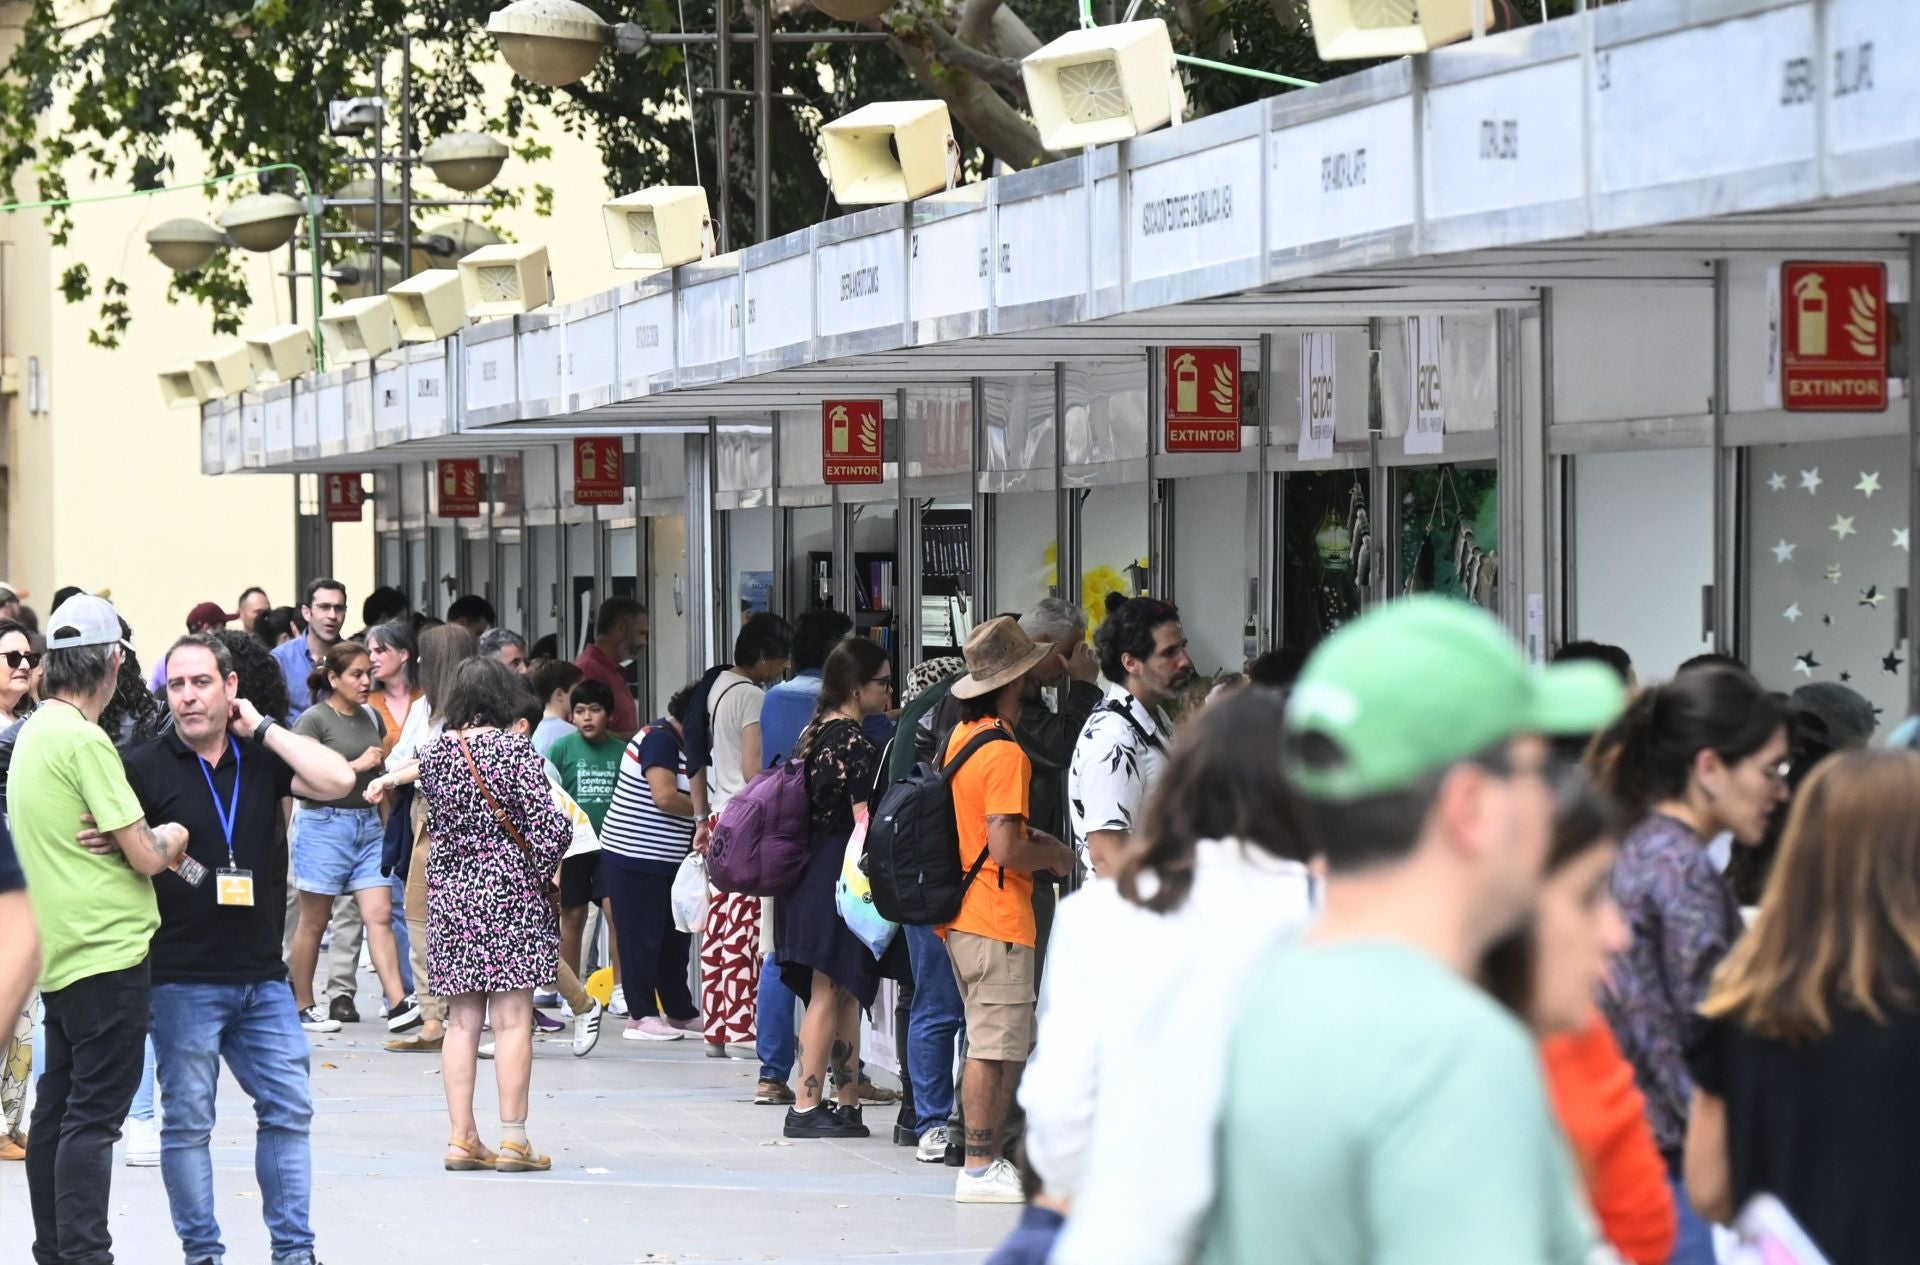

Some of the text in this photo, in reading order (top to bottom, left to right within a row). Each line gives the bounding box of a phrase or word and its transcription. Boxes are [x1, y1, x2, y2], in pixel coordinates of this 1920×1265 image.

[1790, 379, 1879, 396] EXTINTOR
[1170, 430, 1235, 441] EXTINTOR
[827, 466, 879, 475] EXTINTOR
[578, 490, 619, 498] EXTINTOR
